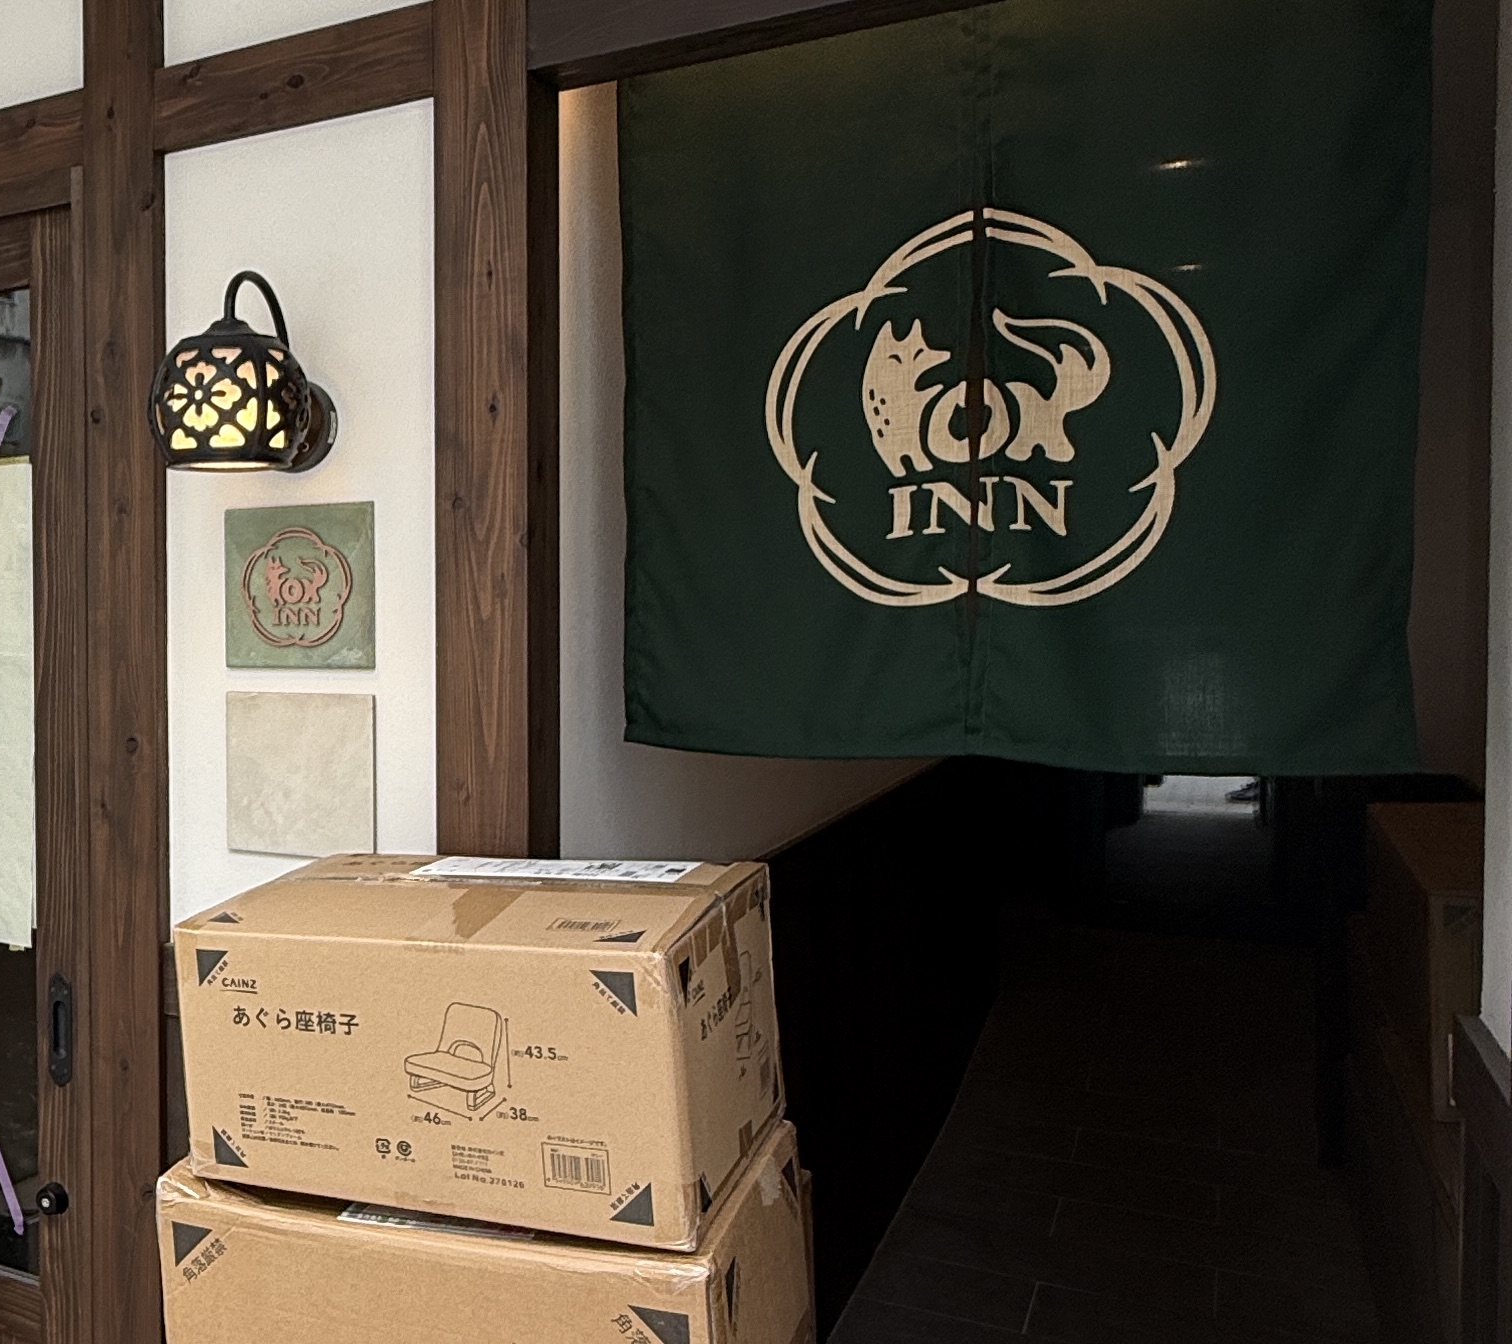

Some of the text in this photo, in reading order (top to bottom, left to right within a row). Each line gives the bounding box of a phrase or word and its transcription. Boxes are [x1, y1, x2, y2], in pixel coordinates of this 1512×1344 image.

[885, 475, 1074, 539] INN
[271, 606, 321, 627] INN
[221, 977, 258, 990] CAINZ
[232, 1006, 360, 1035] あぐら座椅子
[181, 1237, 229, 1284] 角落厳禁
